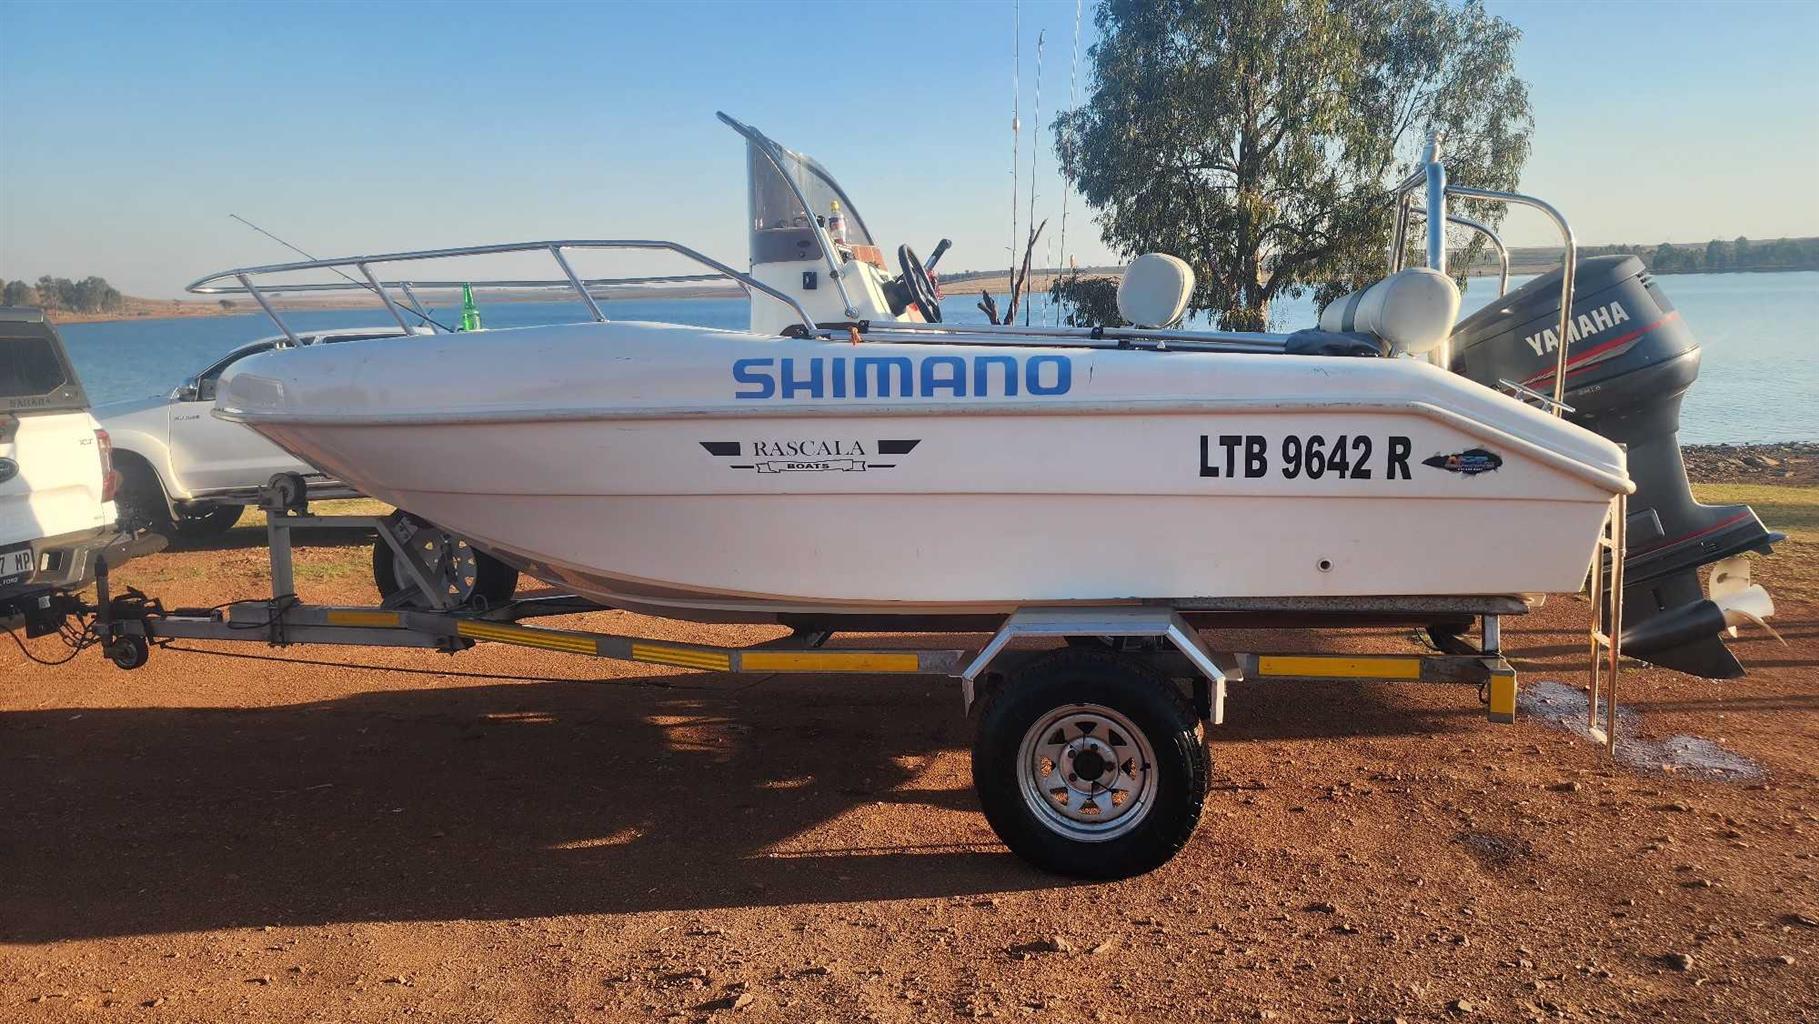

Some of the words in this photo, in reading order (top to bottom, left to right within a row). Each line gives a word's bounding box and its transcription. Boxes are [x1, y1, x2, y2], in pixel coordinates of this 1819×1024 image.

[1525, 301, 1631, 357] YAMAHA
[732, 355, 1072, 399] SHIMANO
[753, 440, 866, 457] RASCALA
[1200, 435, 1268, 478] LTB
[1281, 435, 1373, 480] 9642
[1386, 436, 1413, 480] R
[15, 552, 30, 571] MP
